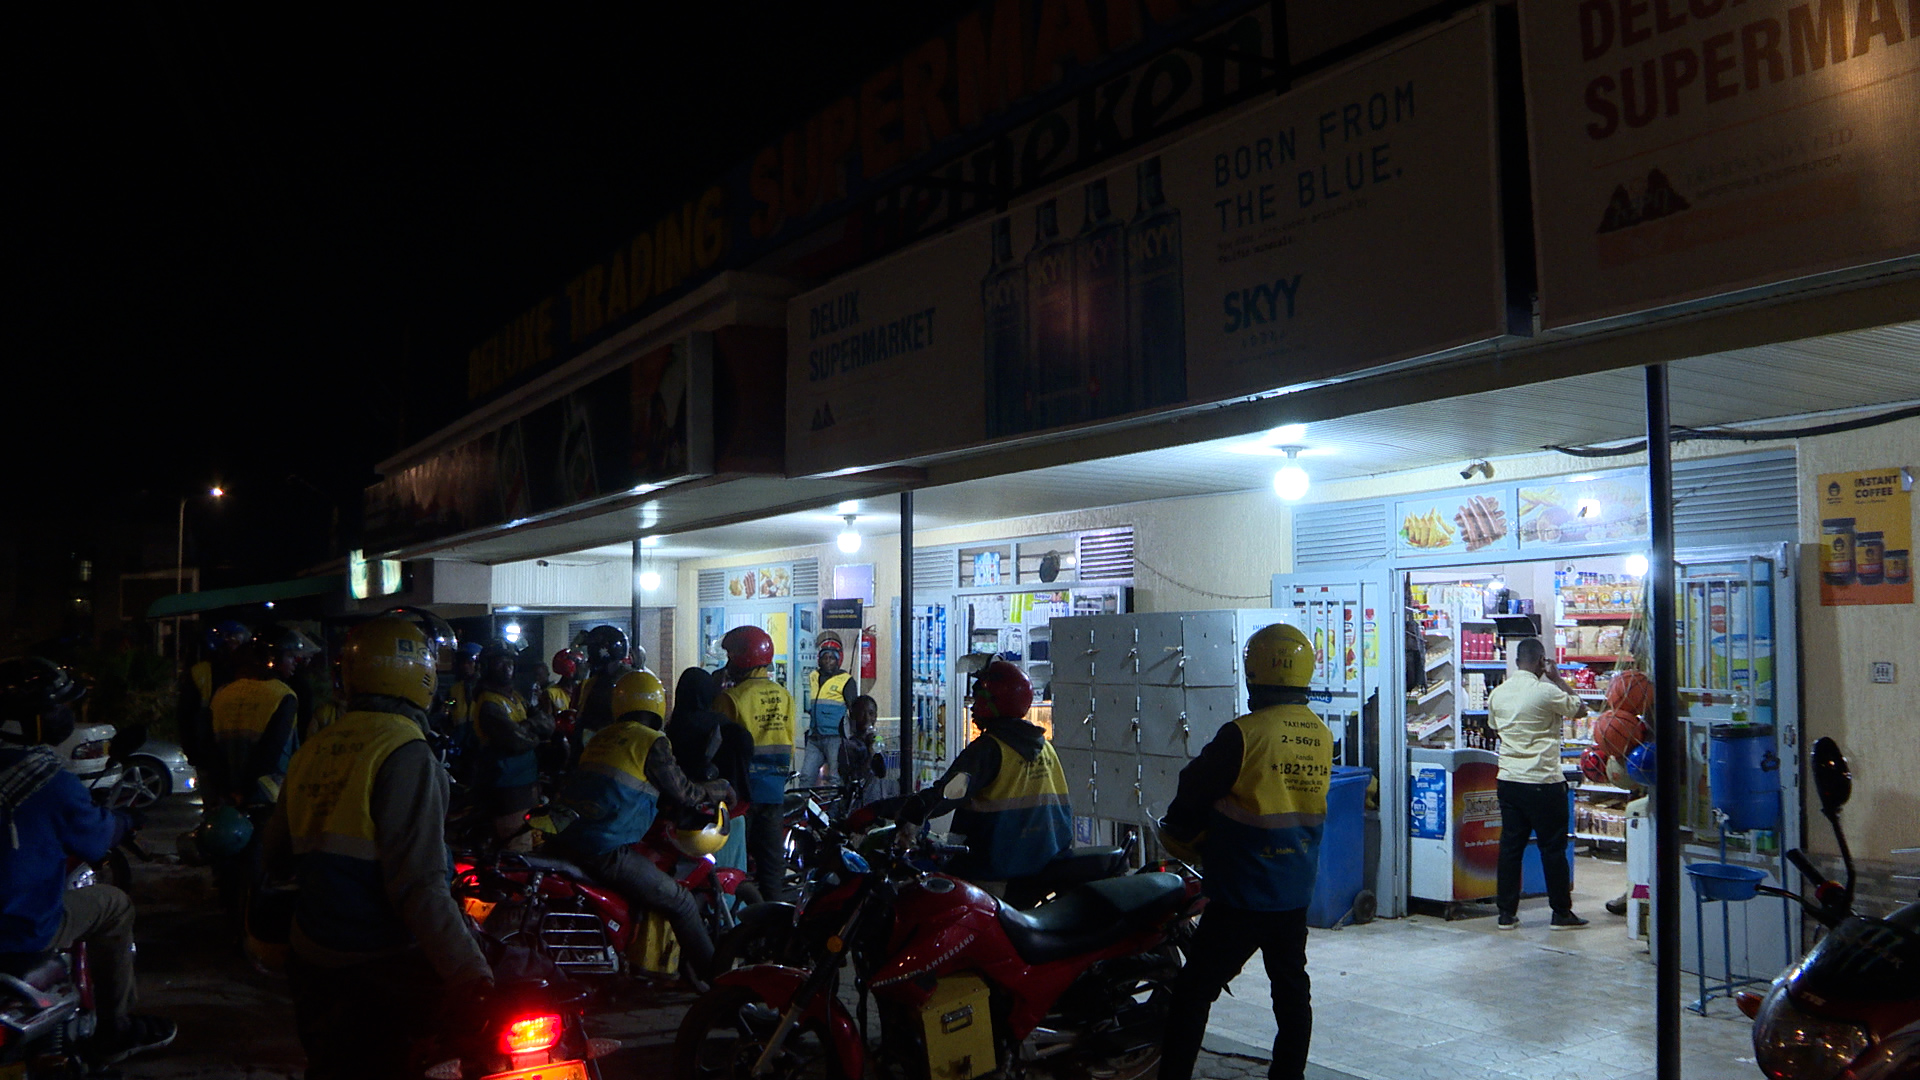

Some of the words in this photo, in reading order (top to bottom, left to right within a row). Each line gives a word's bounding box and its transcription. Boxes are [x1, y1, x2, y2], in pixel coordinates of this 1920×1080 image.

[1584, 0, 1920, 141] SUPERMA
[1214, 126, 1296, 188] BORN
[1318, 80, 1415, 150] FROM
[1214, 183, 1278, 233] THE
[1297, 143, 1403, 209] BLUE.
[564, 184, 726, 346] TRADING
[809, 289, 860, 340] DELUX
[1223, 273, 1303, 333] SKYY
[809, 307, 936, 382] SUPERMARKET
[1854, 475, 1898, 487] INSTANT
[1855, 487, 1893, 498] COFFEE
[1281, 734, 1321, 747] 2-5678
[1283, 720, 1299, 728] TAXI
[1301, 721, 1319, 729] MOTO
[925, 933, 976, 972] AMPERSAND
